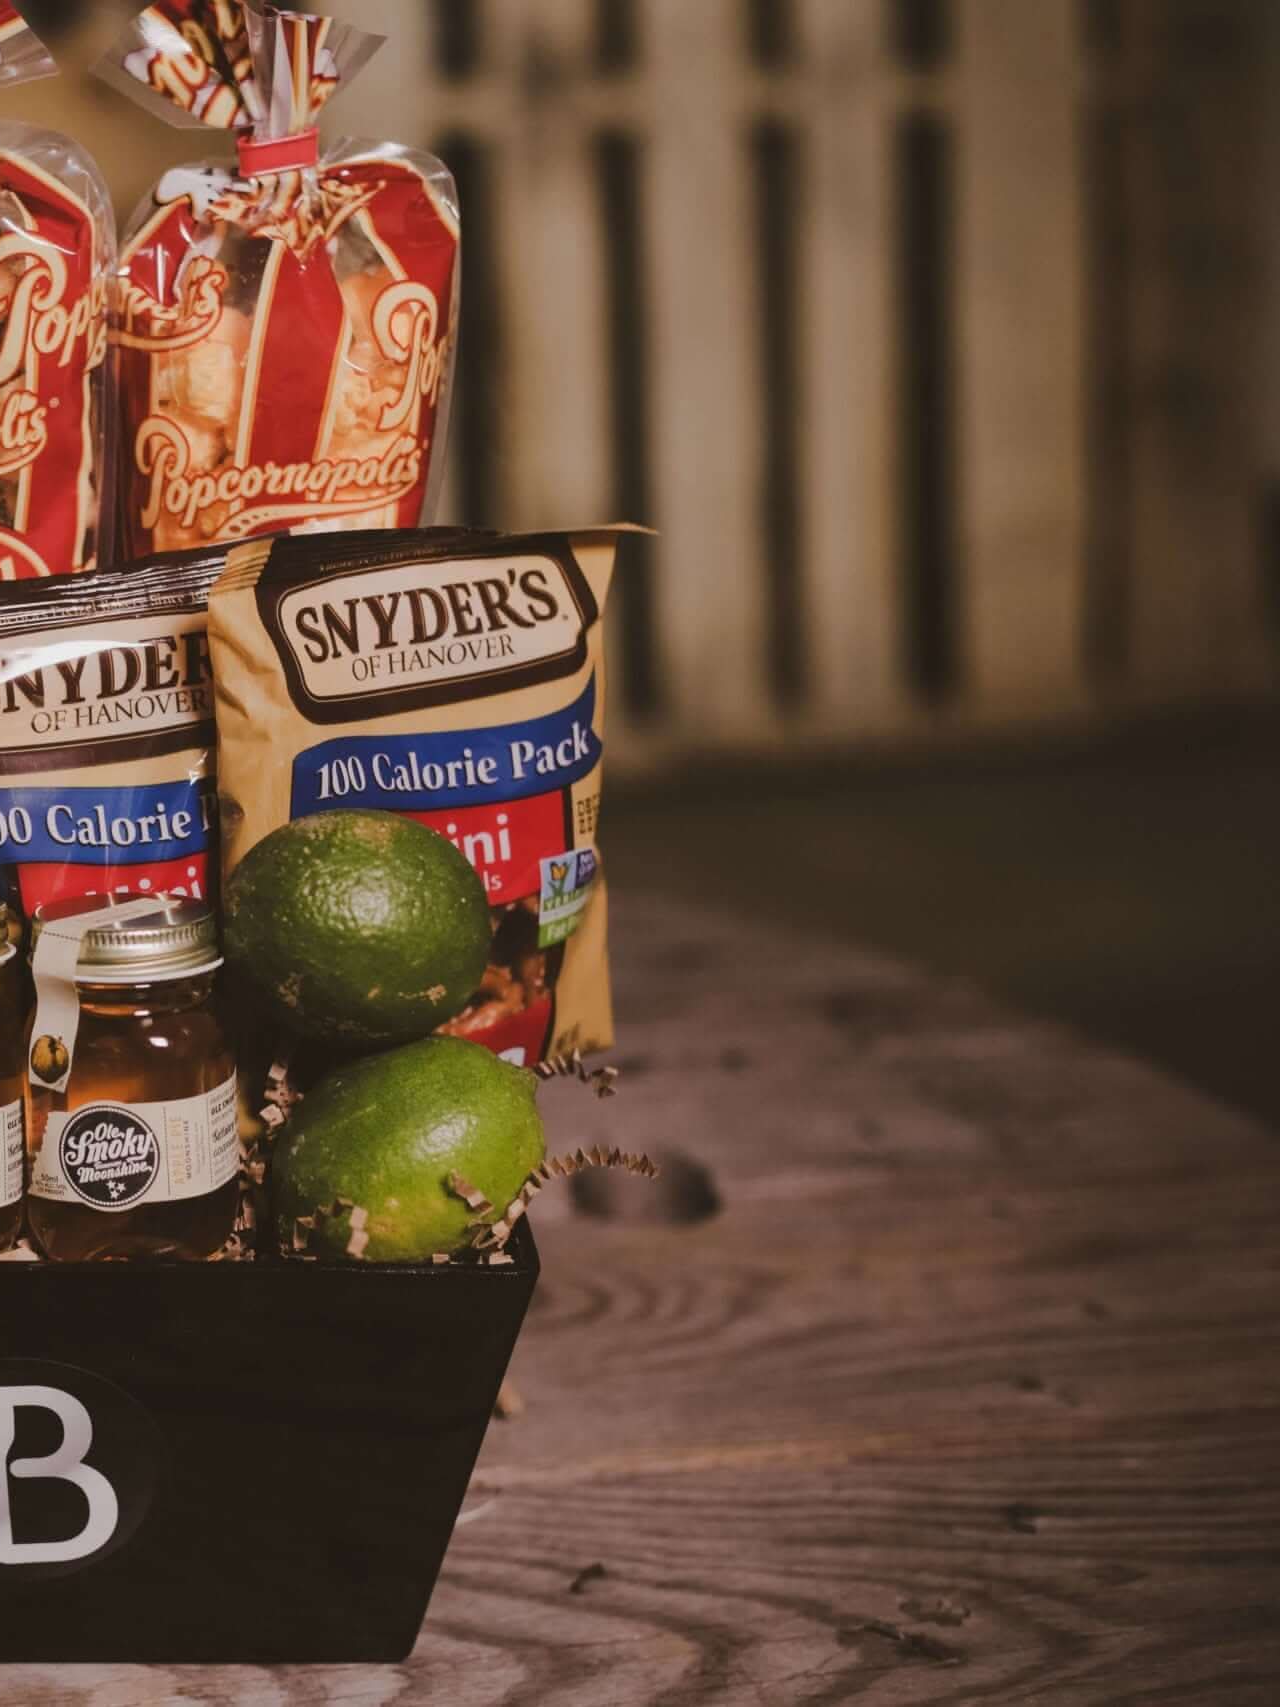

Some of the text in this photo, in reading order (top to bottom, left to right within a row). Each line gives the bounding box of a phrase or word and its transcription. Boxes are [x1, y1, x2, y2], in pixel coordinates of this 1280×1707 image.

[135, 414, 421, 530] Popcornopolis
[294, 568, 560, 664] SNYDER'S
[351, 635, 516, 683] OF HANOVER
[30, 710, 68, 735] OF
[316, 720, 592, 800] 100 Calorie Pack
[45, 802, 193, 847] Calorie
[65, 1127, 153, 1166] Smoky
[94, 1122, 125, 1141] Ole
[76, 1161, 153, 1184] Moonshine
